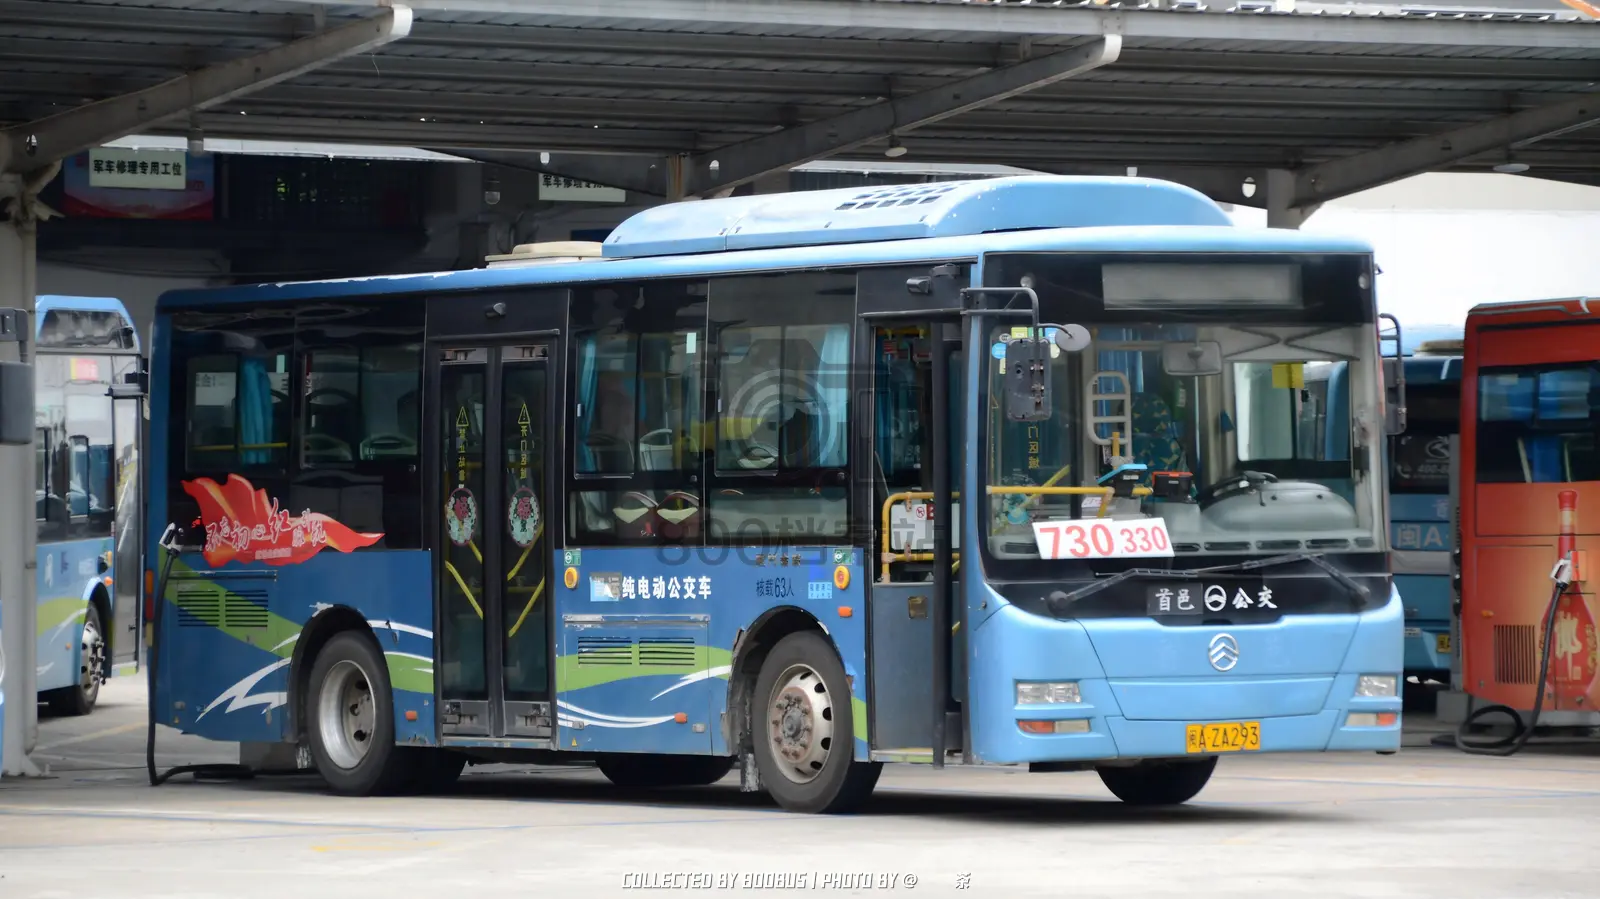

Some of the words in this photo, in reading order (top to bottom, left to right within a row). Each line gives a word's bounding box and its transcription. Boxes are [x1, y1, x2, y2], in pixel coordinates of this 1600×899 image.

[93, 160, 183, 176] 军车修理专用工位
[1039, 523, 1114, 559] 730
[1120, 525, 1168, 553] 330
[622, 575, 712, 600] 纯电动公交车
[756, 577, 795, 598] 核载63人
[1155, 588, 1195, 612] 首邑
[1231, 586, 1278, 610] 公交
